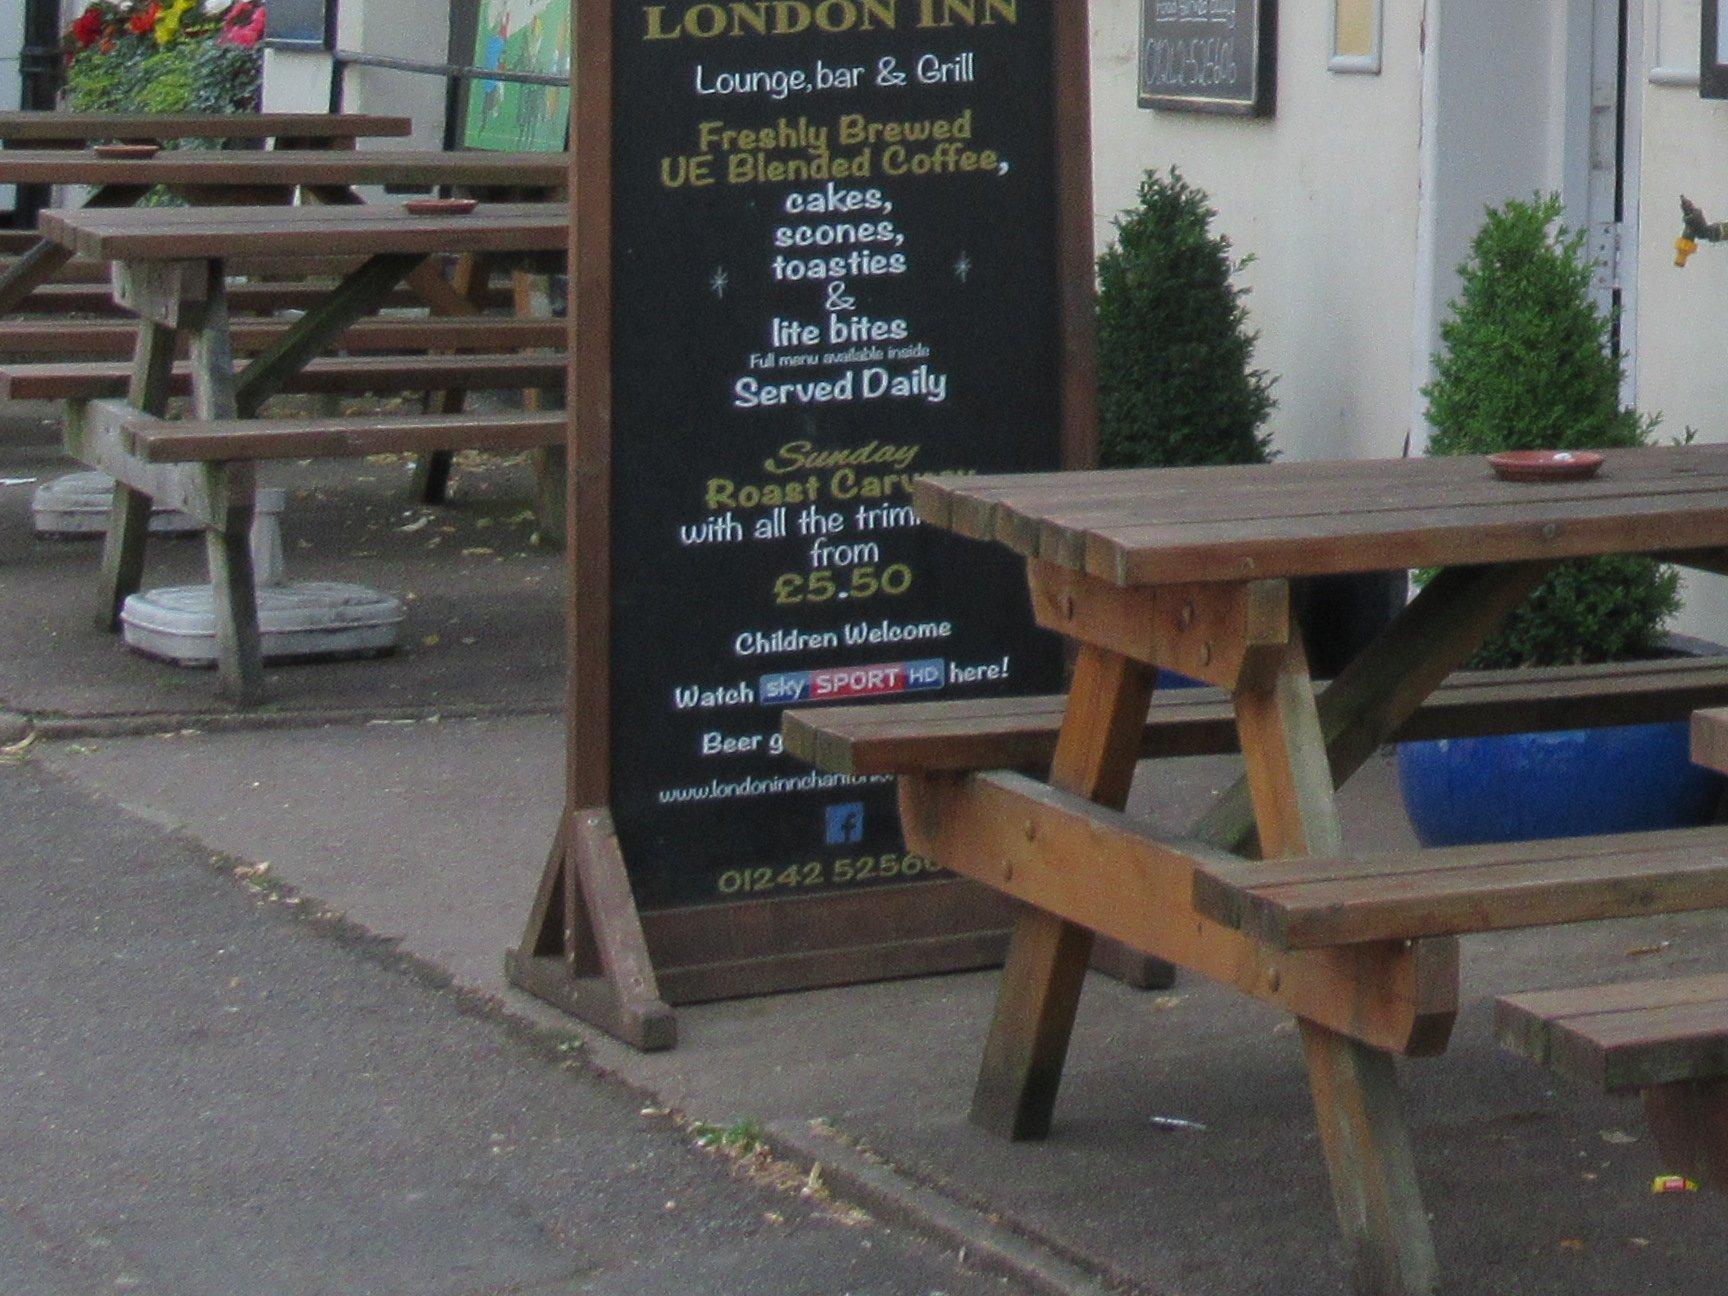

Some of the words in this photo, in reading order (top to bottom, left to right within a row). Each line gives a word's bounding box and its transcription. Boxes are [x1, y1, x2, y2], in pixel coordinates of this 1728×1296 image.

[876, 56, 906, 86] &
[917, 52, 975, 84] Grill
[699, 116, 829, 155] Freshly
[839, 109, 972, 145] Brewed
[727, 147, 871, 184] Blended
[882, 142, 1010, 177] Coffee,
[785, 182, 893, 215] cakes,
[774, 220, 905, 249] scones,
[772, 249, 908, 282] toasties
[824, 281, 856, 311] &
[772, 318, 821, 348] lite
[829, 312, 909, 345] bites
[750, 352, 776, 369] Full
[779, 353, 820, 368] menu
[824, 345, 884, 365] available
[888, 342, 931, 360] inside
[734, 369, 854, 408] Served
[862, 363, 948, 403] Daily
[764, 440, 921, 475] Sunday
[705, 475, 820, 509] Roast
[680, 511, 743, 545] with
[754, 507, 787, 539] all
[798, 504, 844, 535] the
[809, 536, 880, 568] from
[774, 563, 912, 605] £5.50
[735, 628, 839, 656] Children
[844, 619, 952, 646] Welcome
[674, 681, 754, 709] Watch
[766, 677, 809, 700] sky
[815, 668, 900, 695] SPORT
[908, 666, 940, 684] HD
[950, 656, 1010, 684] here!
[702, 731, 763, 756] Beer
[717, 861, 826, 894] 01242
